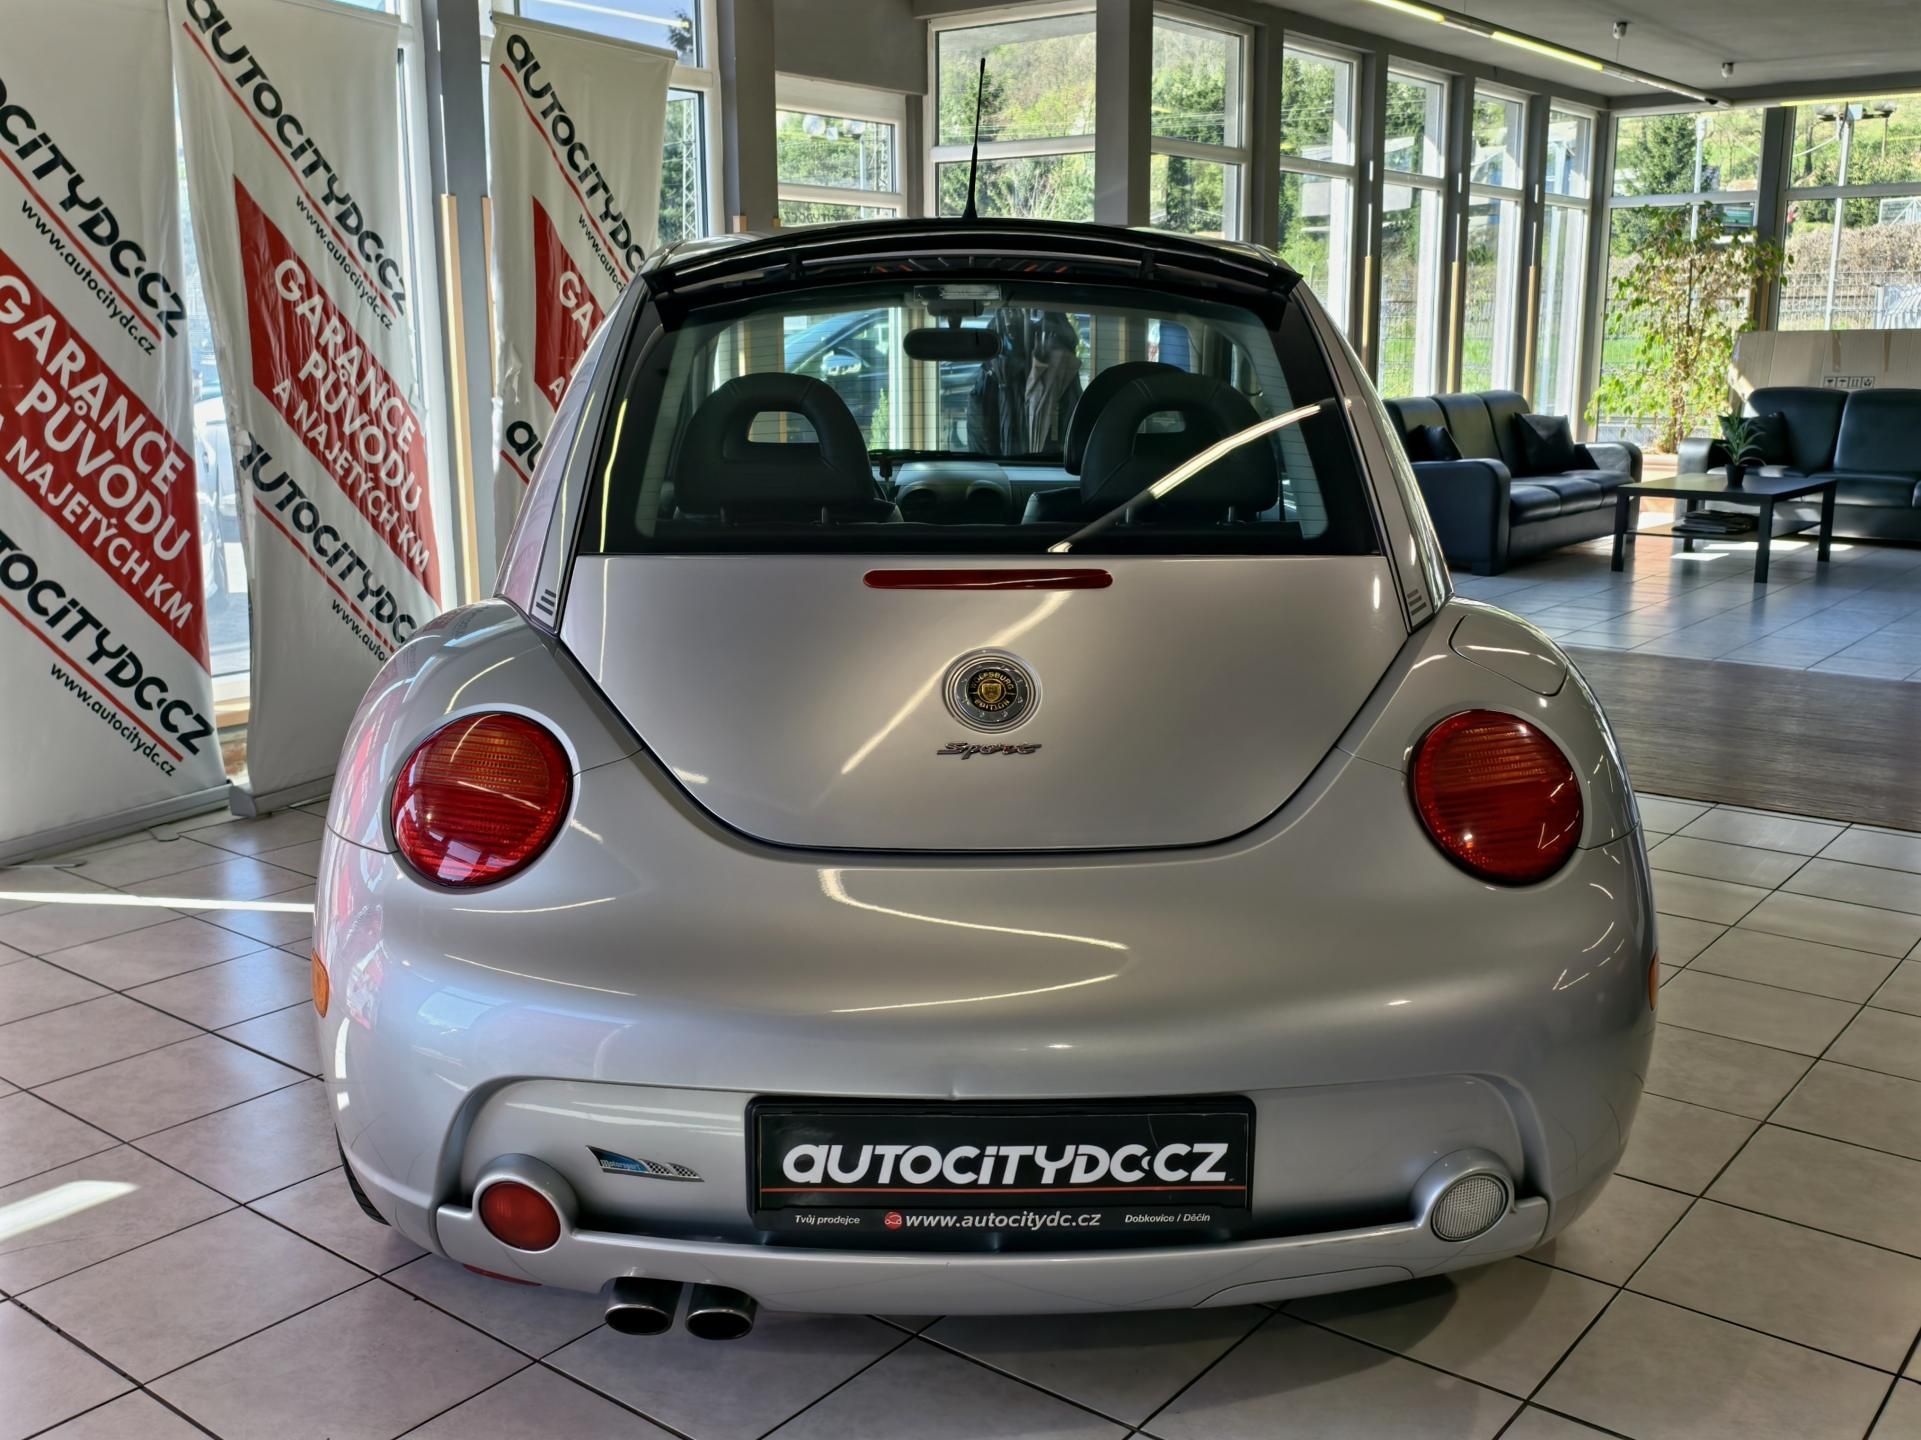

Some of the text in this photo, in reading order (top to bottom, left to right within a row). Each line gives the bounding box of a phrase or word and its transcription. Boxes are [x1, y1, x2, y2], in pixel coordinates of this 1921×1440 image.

[21, 199, 156, 356] www.autocitydc.cz
[295, 194, 393, 331] www.autocitydc.cz
[0, 275, 185, 494] GARANCE
[274, 259, 416, 453] GARANCE
[549, 376, 566, 402] A
[15, 377, 191, 561] PŮVODU
[273, 378, 292, 408] A
[397, 525, 430, 573] KM
[144, 573, 193, 629] KM
[332, 599, 389, 663] www.auto
[50, 663, 176, 777] www.autocitydc.cz
[817, 1215, 860, 1226] prodejce
[906, 1211, 1101, 1230] www.autocitydc.cz
[1125, 1214, 1175, 1223] Dobkovice
